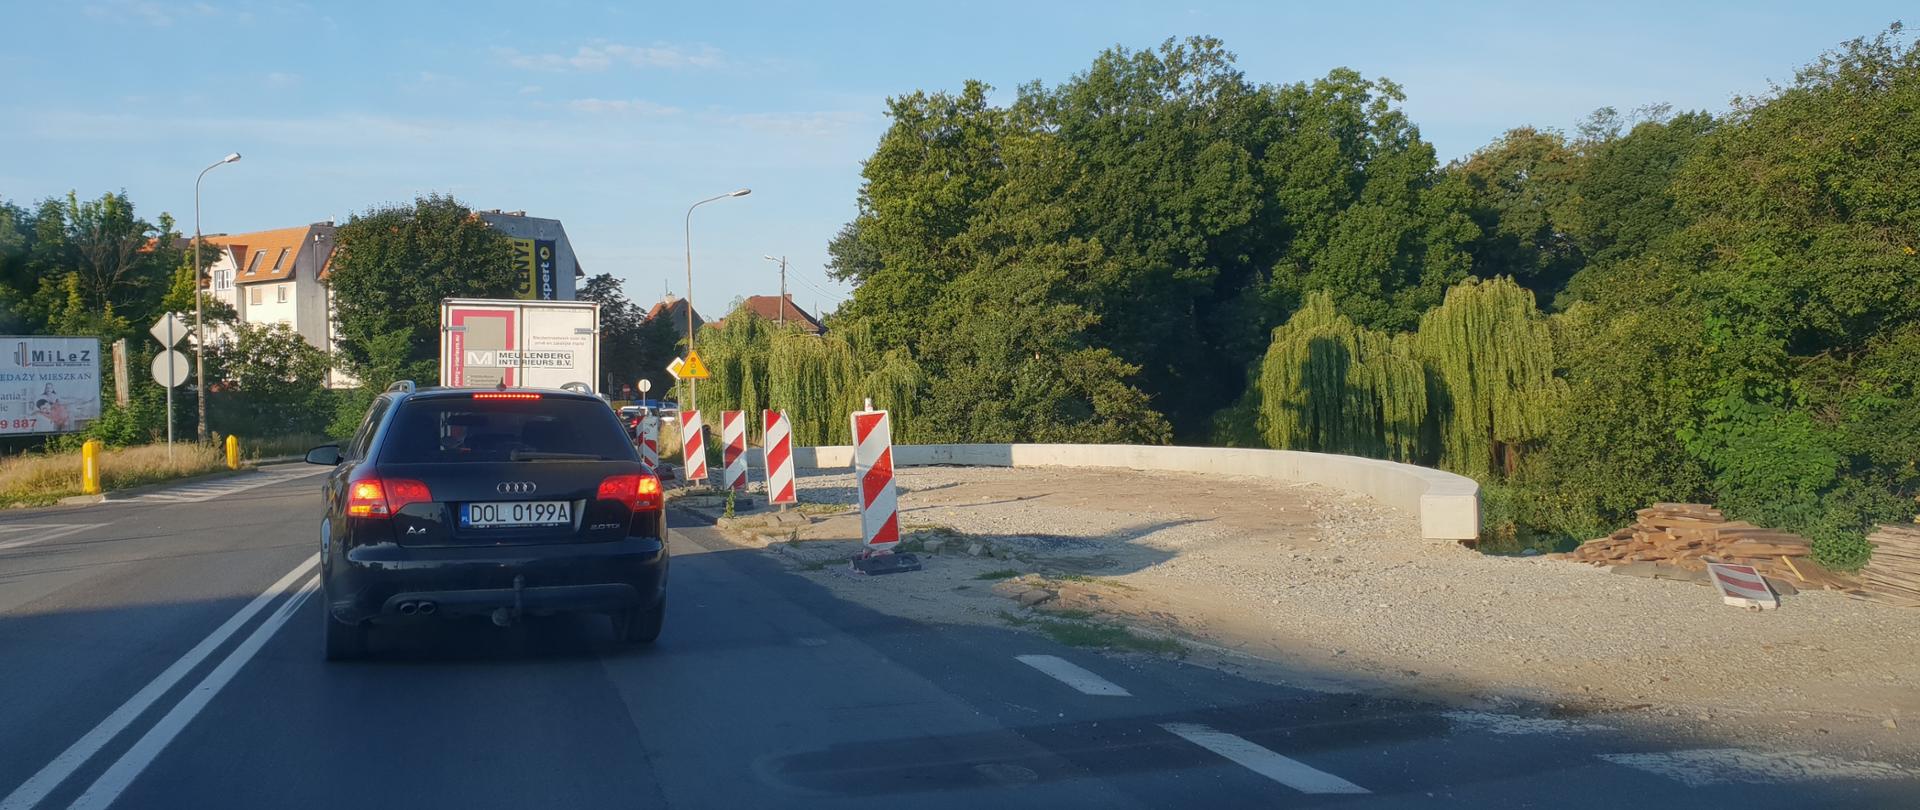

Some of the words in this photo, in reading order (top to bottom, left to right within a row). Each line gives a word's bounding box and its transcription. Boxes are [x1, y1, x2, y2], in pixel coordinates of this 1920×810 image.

[541, 262, 552, 300] xpert
[31, 350, 91, 362] MiLeZ
[467, 352, 493, 365] M
[498, 352, 571, 360] MEULENBERG
[498, 359, 554, 367] INTERIEURS
[13, 418, 37, 430] 887
[471, 505, 506, 523] DOL
[513, 503, 568, 521] 0199A
[407, 525, 427, 535] A4
